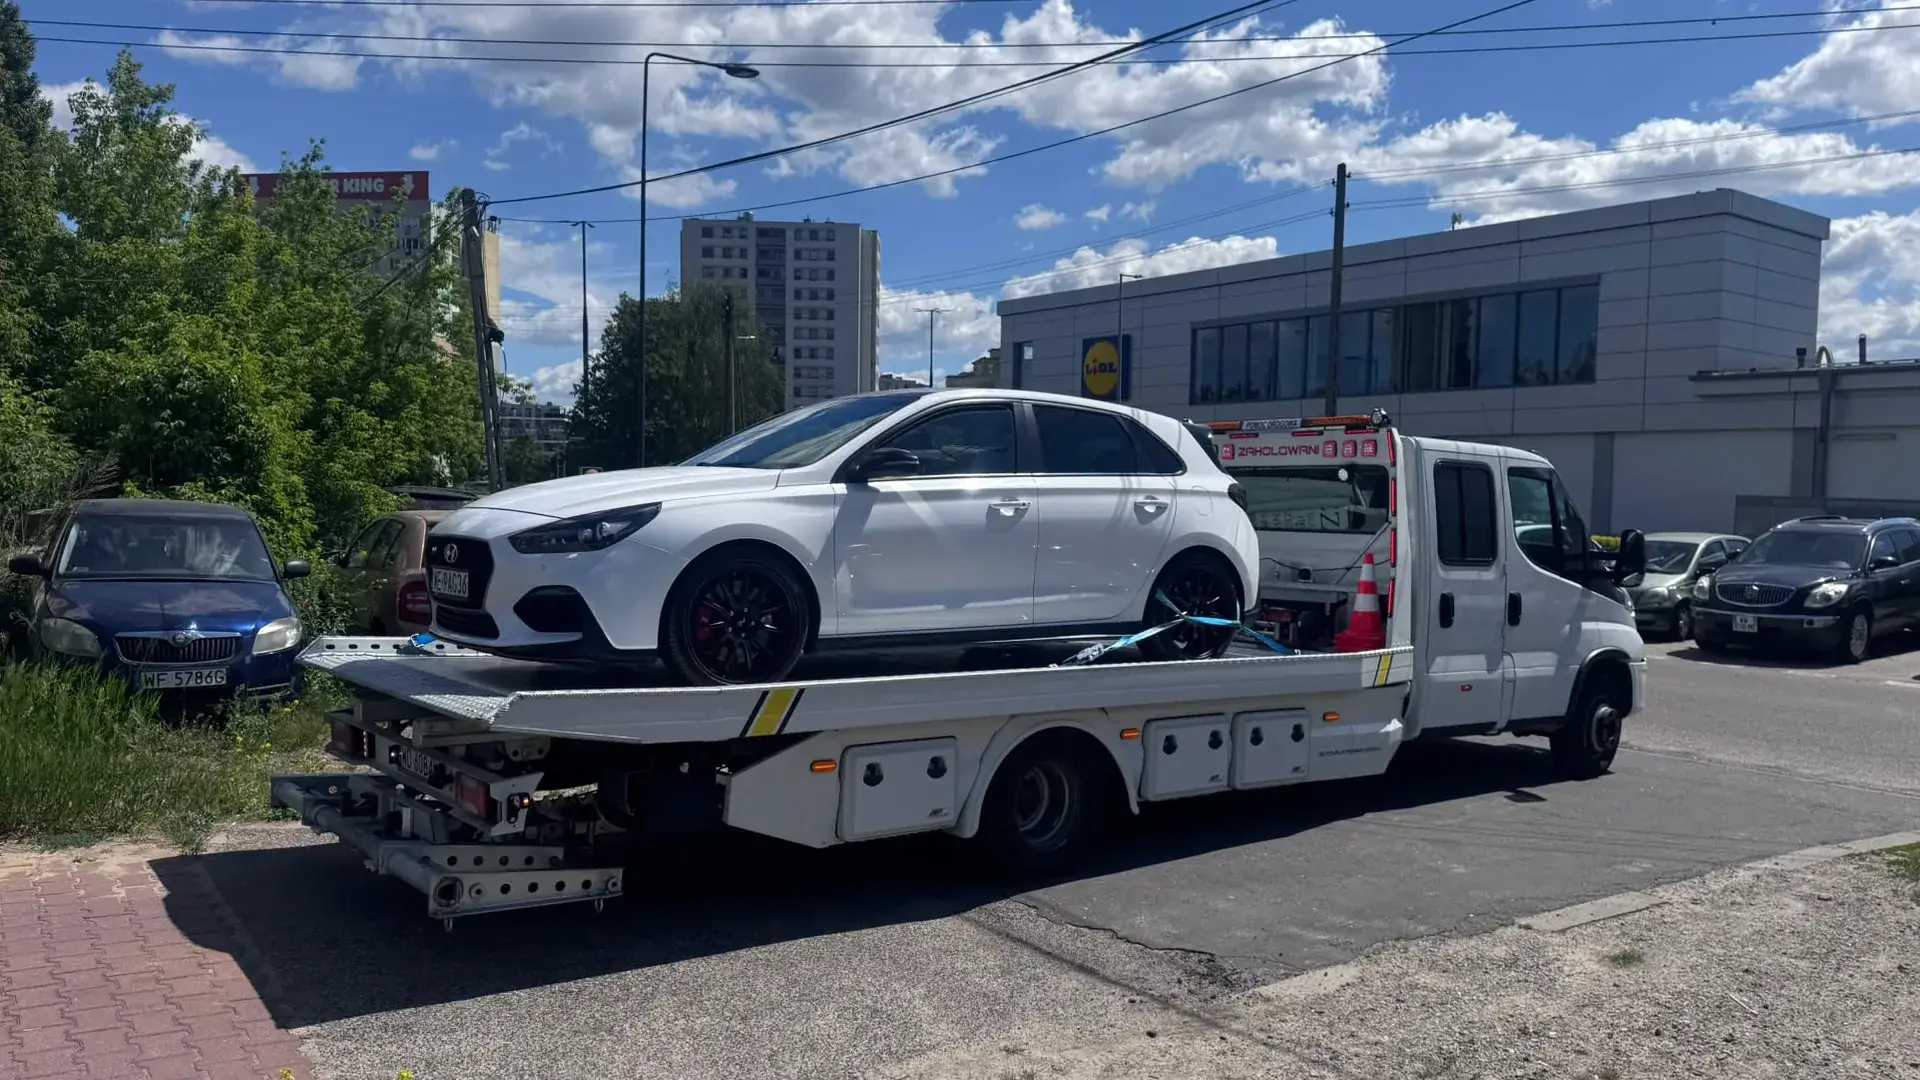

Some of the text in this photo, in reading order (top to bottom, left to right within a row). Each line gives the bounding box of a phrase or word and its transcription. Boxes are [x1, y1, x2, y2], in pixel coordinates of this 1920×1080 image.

[343, 178, 385, 193] KING
[1246, 421, 1267, 430] POMOC
[1238, 444, 1320, 457] ZAHOLOWANI
[144, 670, 226, 687] WF 5786G
